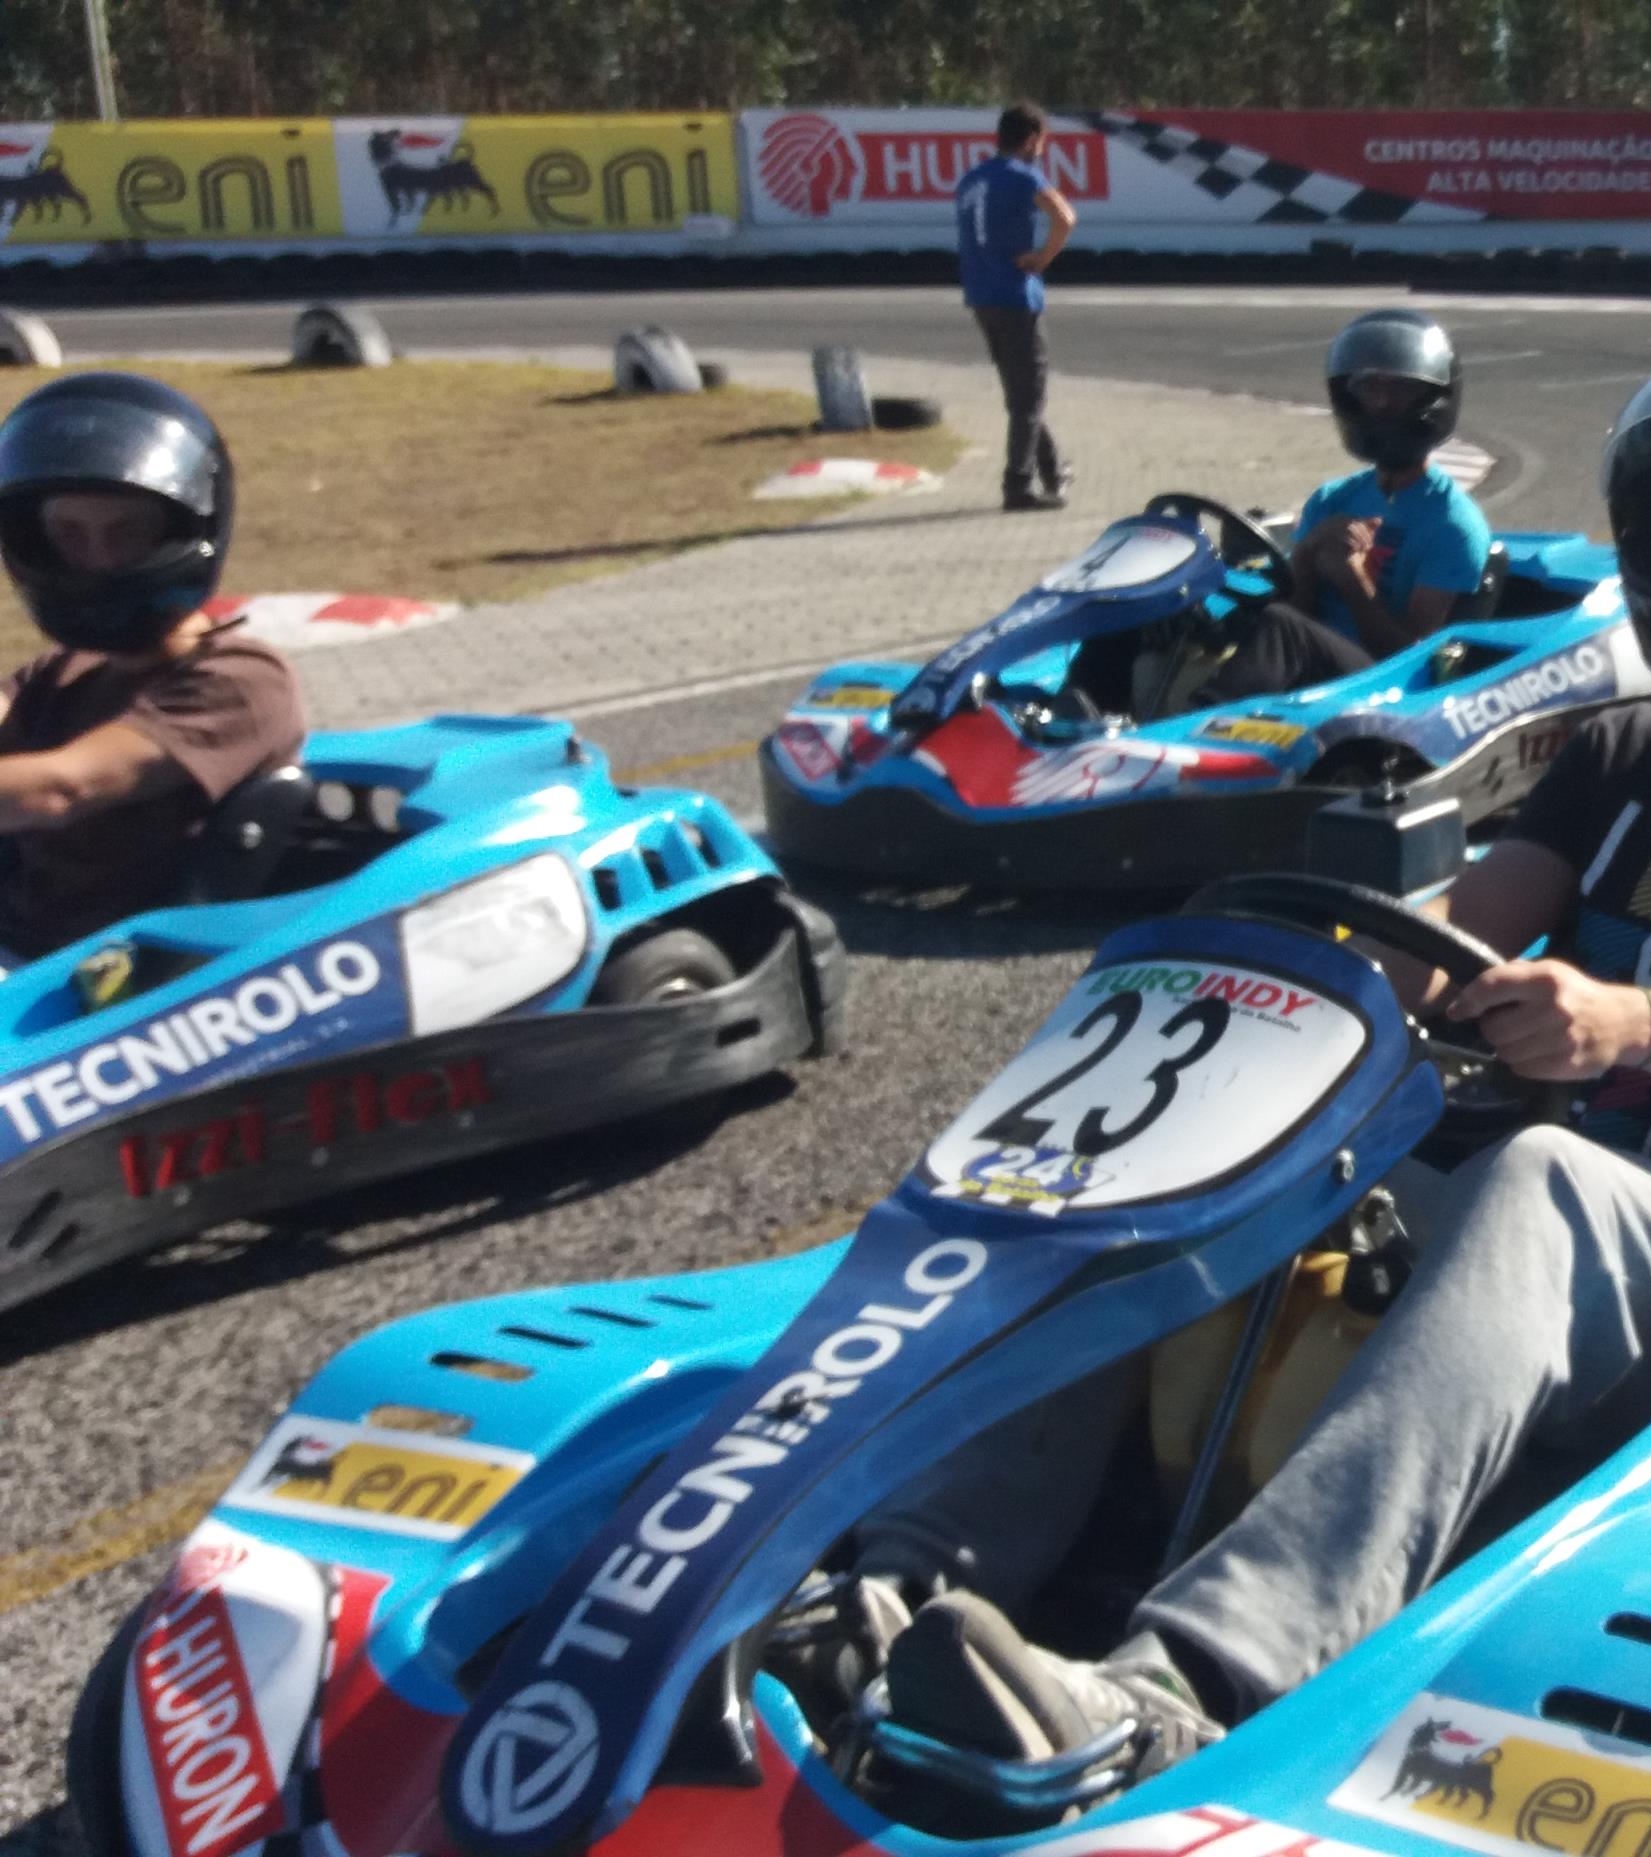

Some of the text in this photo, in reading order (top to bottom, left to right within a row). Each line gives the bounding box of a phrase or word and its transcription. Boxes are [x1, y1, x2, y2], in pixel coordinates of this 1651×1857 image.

[117, 129, 314, 234] eni
[524, 123, 712, 226] eni
[883, 140, 1088, 194] HUN
[1364, 138, 1481, 163] CENTROS
[1427, 170, 1651, 192] ALTA VELOCIDADE
[1443, 645, 1603, 740] TECNIROLO
[0, 939, 381, 1142] TECNIROLO
[972, 989, 1232, 1155] 23
[341, 1460, 504, 1525] eni
[541, 1237, 988, 1668] TECNIROLO
[145, 1613, 267, 1855] HURON
